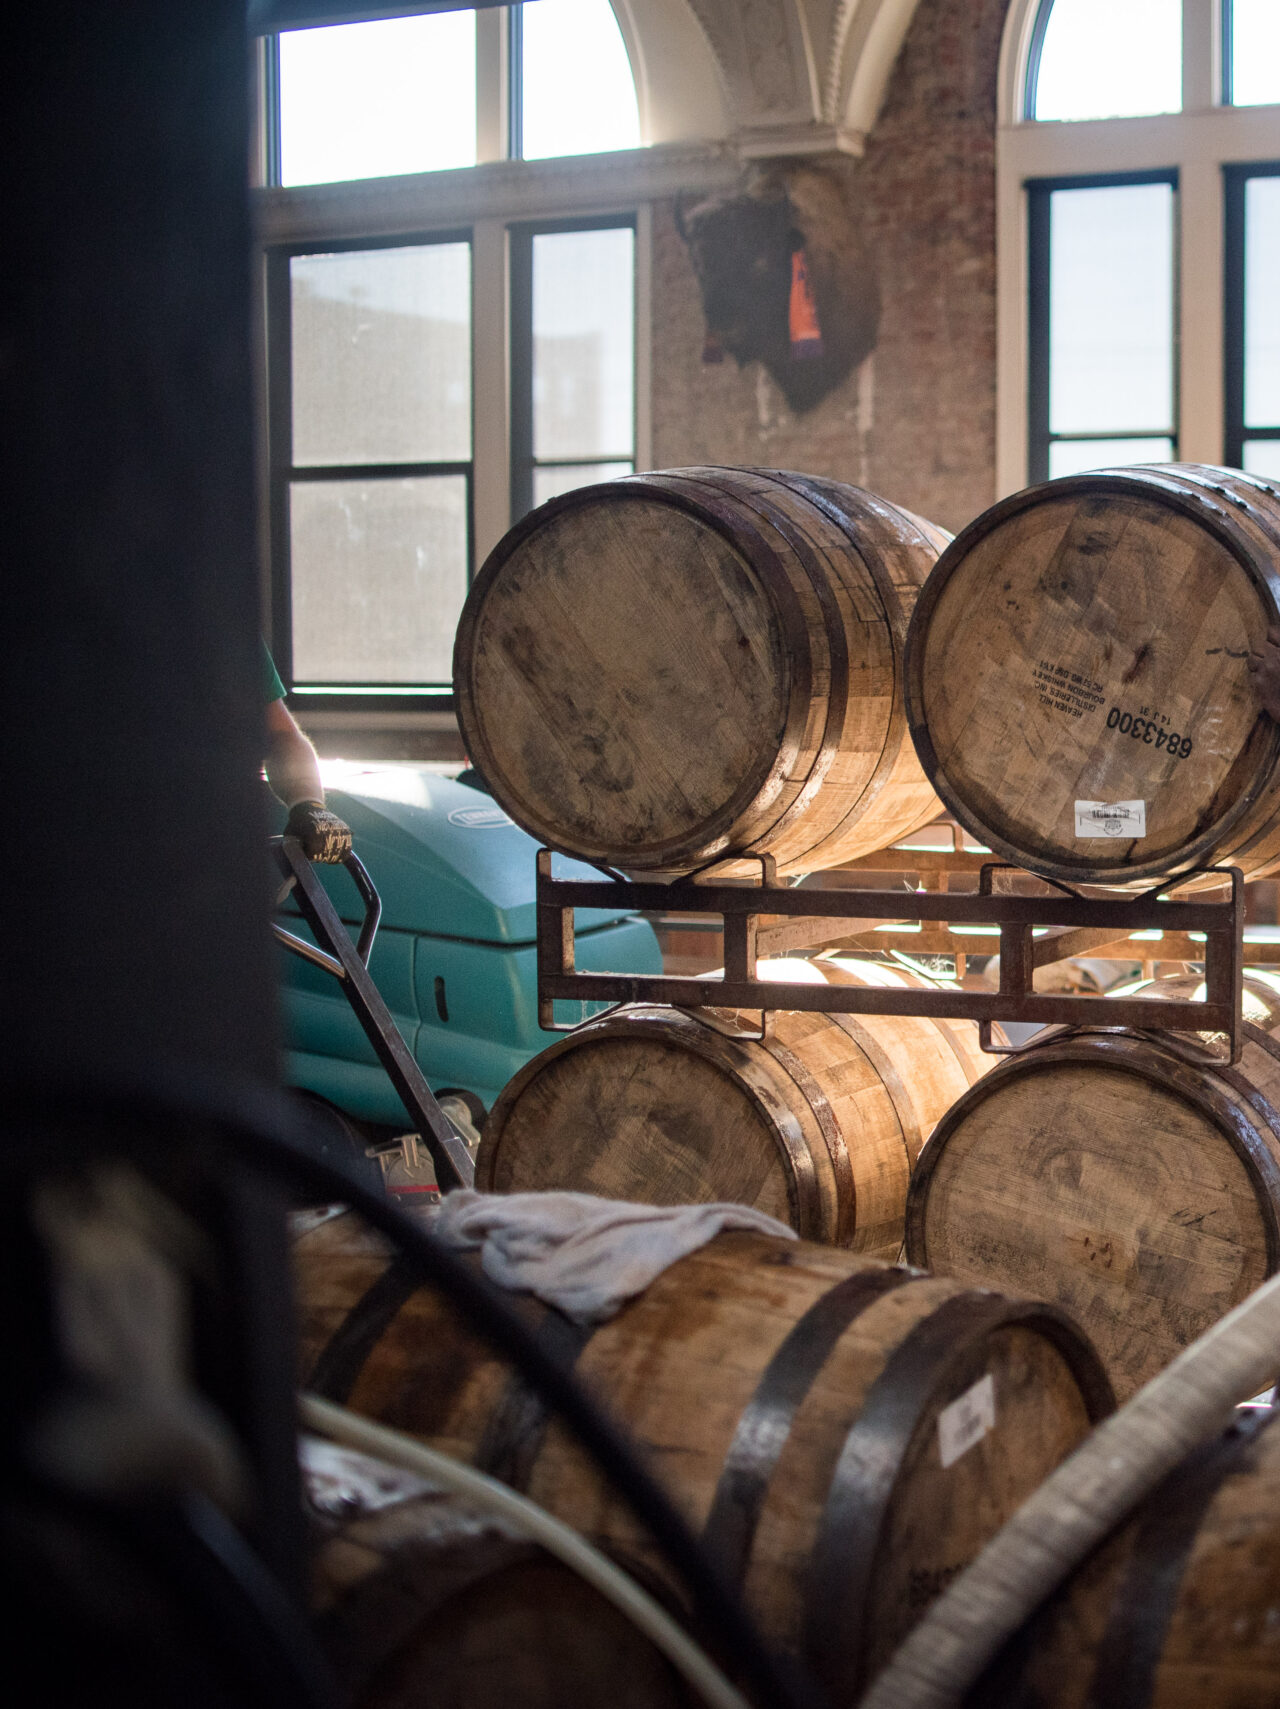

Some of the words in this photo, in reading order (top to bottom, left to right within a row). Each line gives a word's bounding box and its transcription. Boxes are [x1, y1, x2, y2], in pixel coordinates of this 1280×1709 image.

[1032, 669, 1066, 689] WHISKEY
[1038, 694, 1054, 706] HILL
[1067, 685, 1105, 704] BOURBON
[1053, 701, 1083, 718] HEAVEN
[1106, 707, 1193, 759] 6843300
